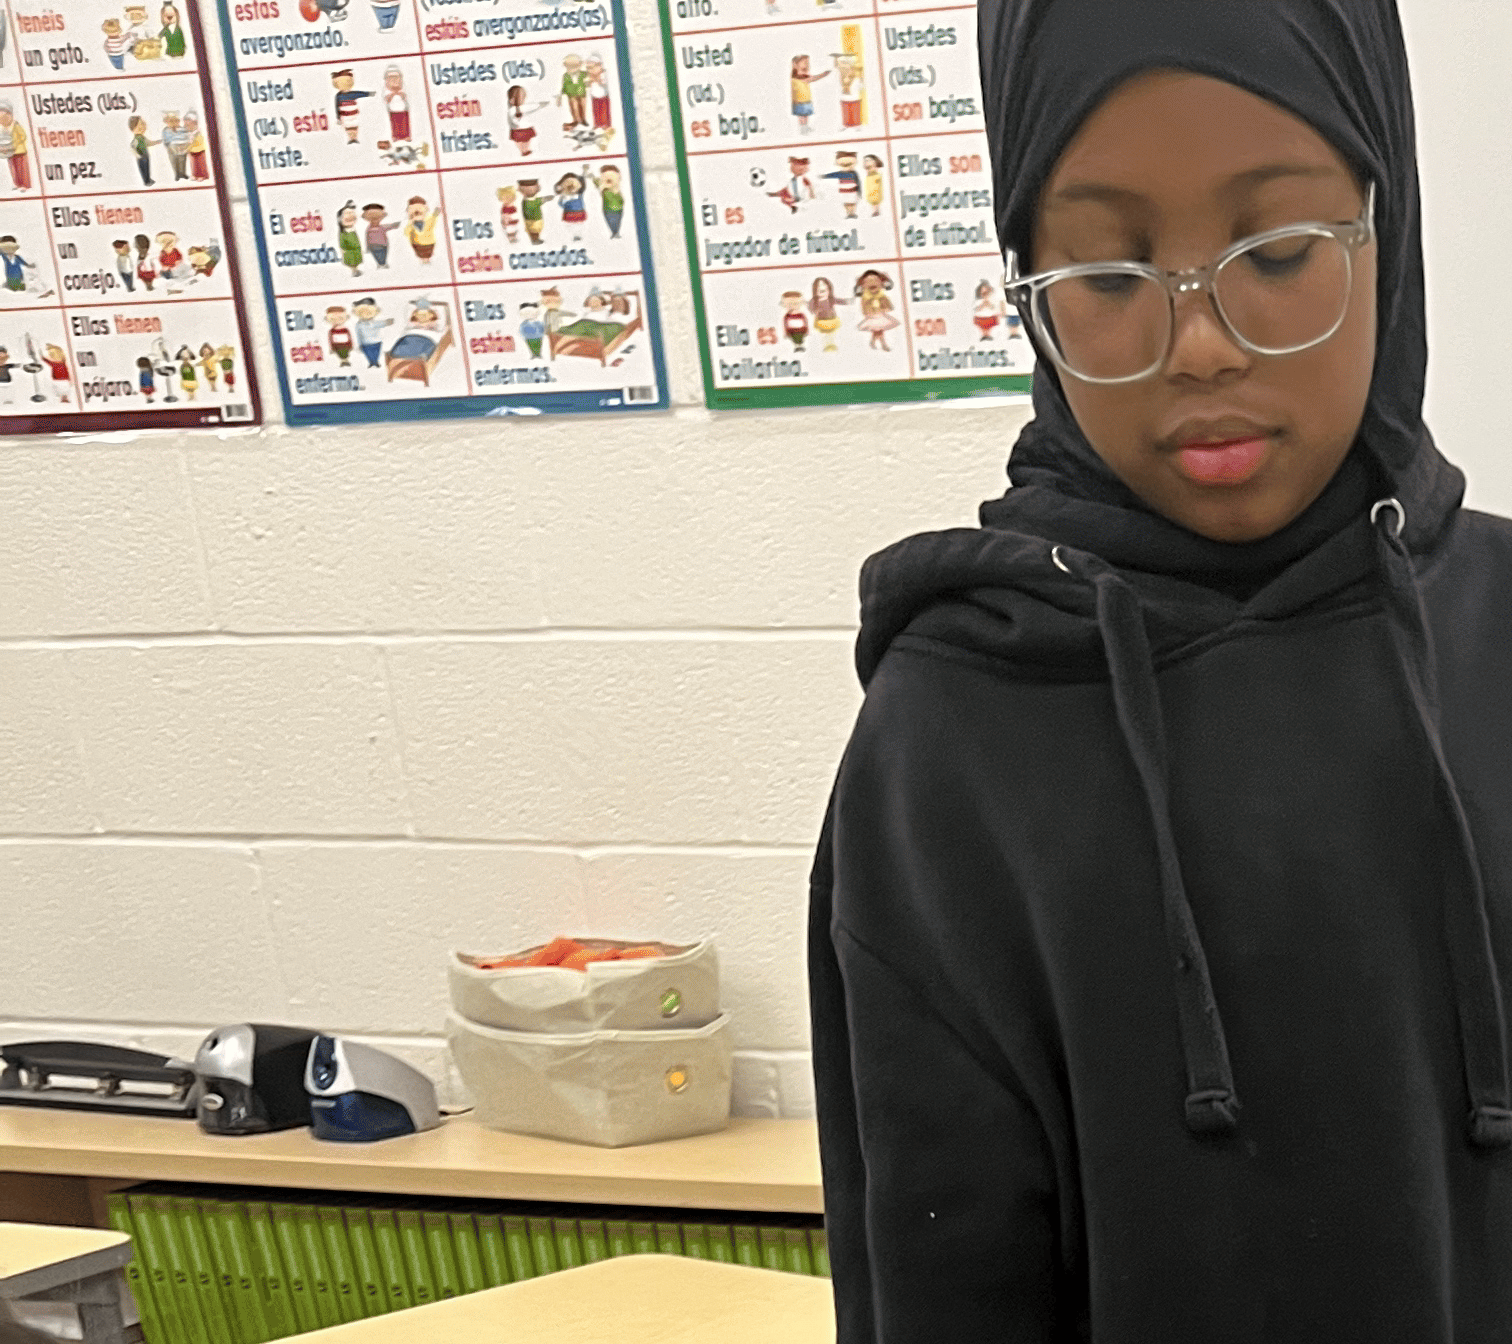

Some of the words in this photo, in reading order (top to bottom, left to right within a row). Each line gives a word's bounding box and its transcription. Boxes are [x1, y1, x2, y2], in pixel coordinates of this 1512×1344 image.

[240, 26, 349, 58] avergonzado.
[885, 24, 957, 50] Ustedes
[24, 49, 43, 66] un
[49, 42, 89, 71] gato.
[682, 43, 733, 69] Usted
[431, 60, 496, 85] Ustedes
[502, 59, 545, 83] (Uds.)
[247, 78, 294, 103] Usted
[31, 92, 93, 115] Ustedes
[97, 92, 138, 115] (Uds.)
[893, 102, 923, 121] son
[293, 108, 329, 133] está
[691, 120, 711, 138] es
[718, 112, 765, 140] baja.
[38, 127, 85, 148] tienen
[441, 129, 498, 153] tristes.
[258, 146, 309, 169] triste.
[950, 154, 982, 173] son
[45, 164, 64, 180] un
[69, 161, 102, 185] pez.
[900, 187, 991, 219] jugadores
[51, 206, 91, 227] Ellos
[95, 204, 144, 225] tienen
[725, 206, 745, 225] es
[905, 225, 926, 247] de
[57, 243, 78, 259] un
[705, 236, 771, 266] jugador
[778, 233, 800, 255] de
[64, 268, 120, 294] conejo.
[114, 313, 162, 334] tienen
[914, 318, 947, 336] son
[757, 327, 778, 345] es
